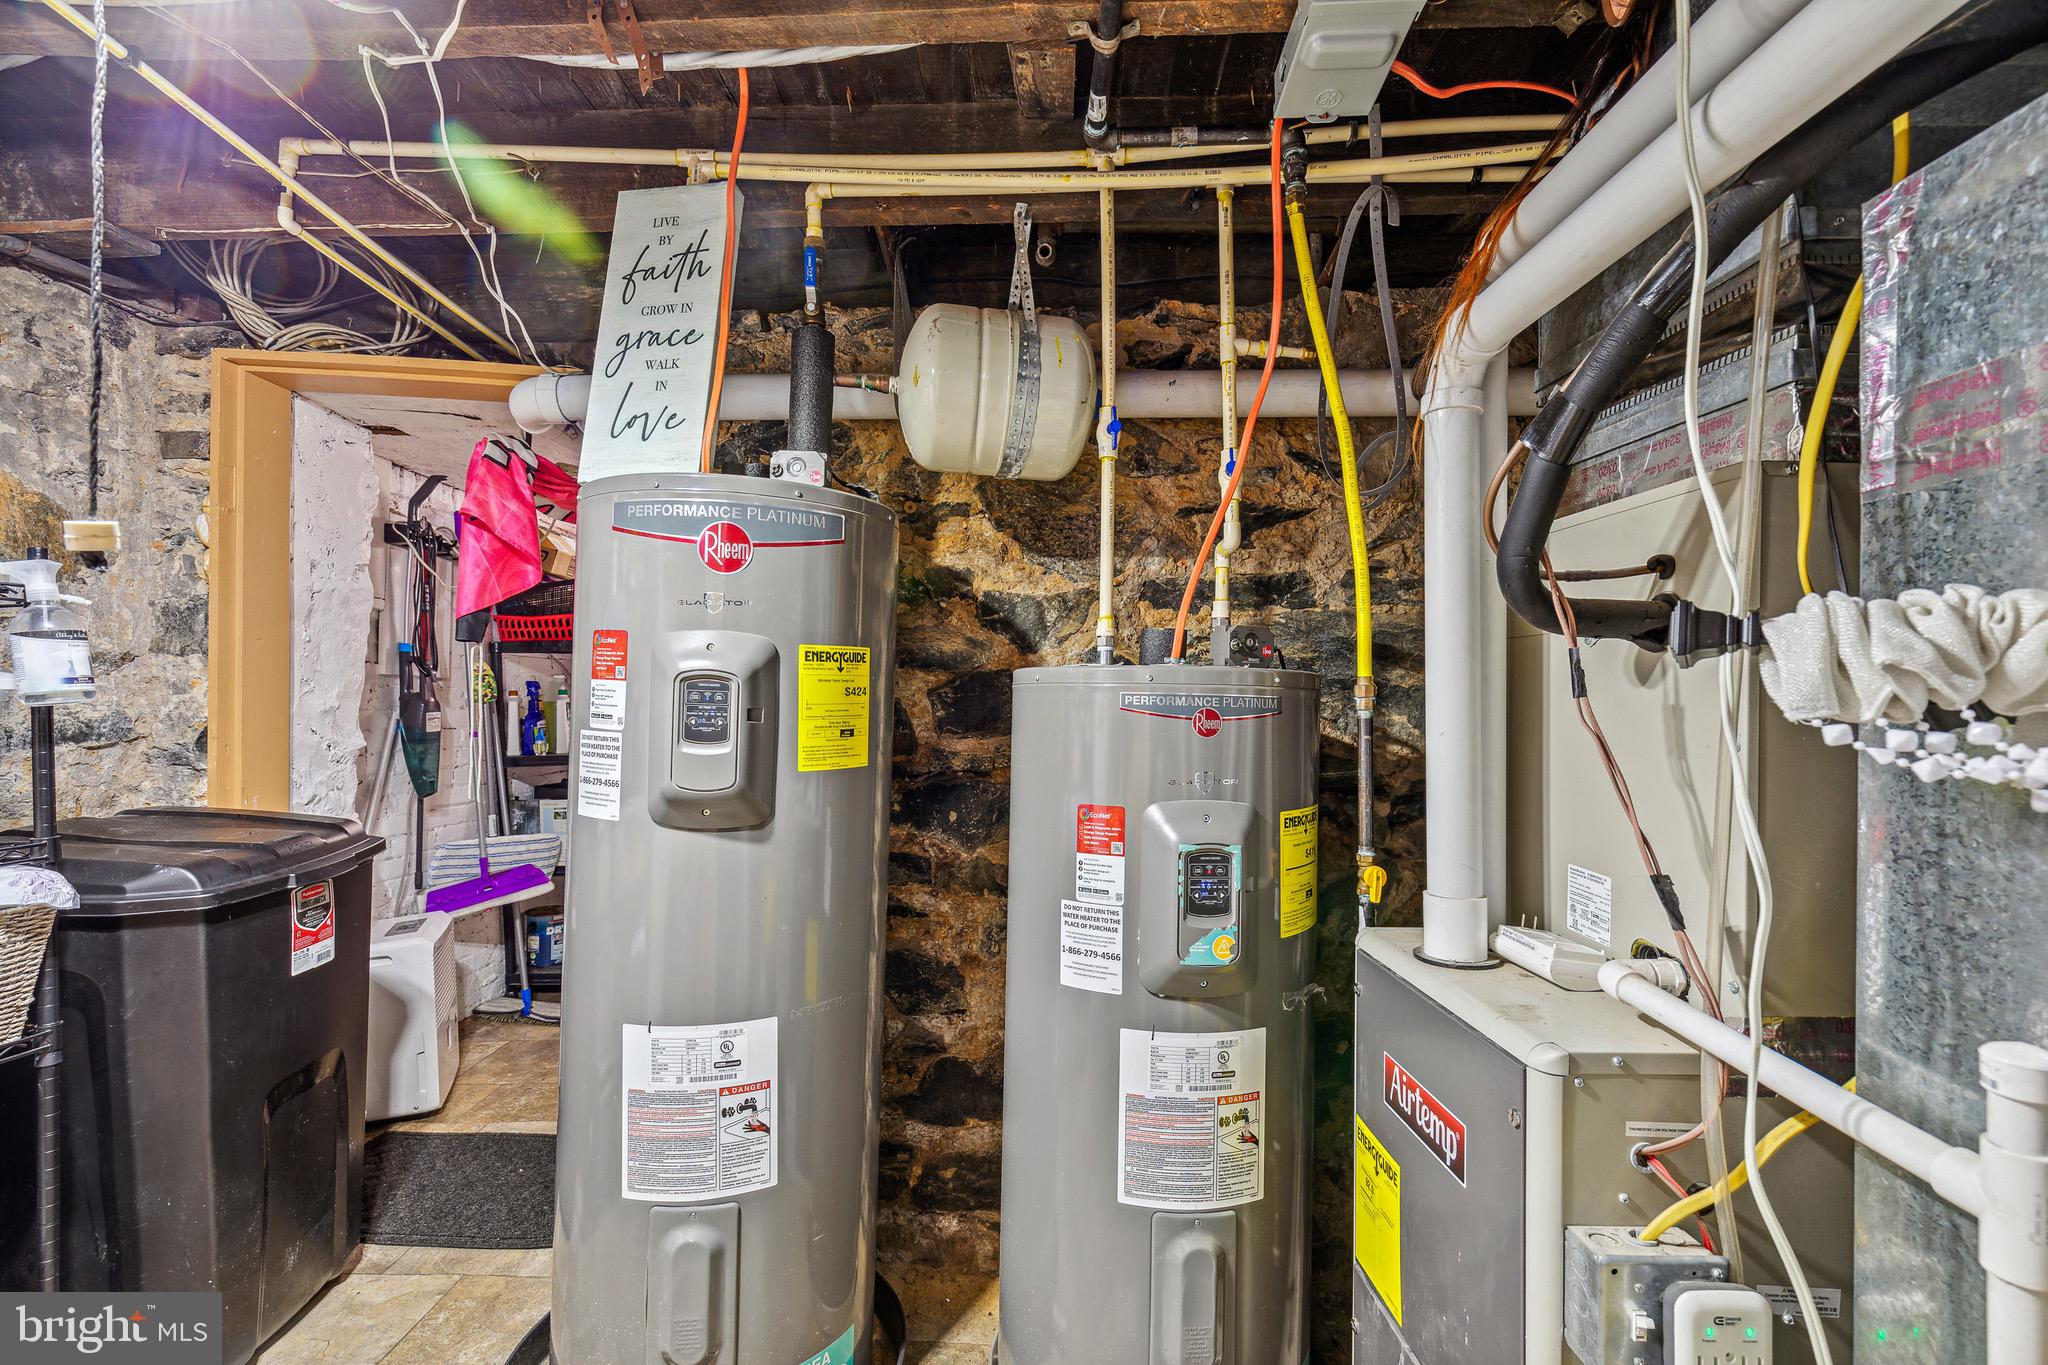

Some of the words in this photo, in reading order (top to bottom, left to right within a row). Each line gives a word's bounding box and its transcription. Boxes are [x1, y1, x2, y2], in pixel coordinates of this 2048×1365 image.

[1432, 153, 1472, 161] CHARLOTTE
[653, 216, 680, 228] LIVE
[659, 235, 674, 246] BY
[622, 229, 711, 305] faith
[641, 304, 678, 317] GROW
[680, 302, 694, 314] IN
[605, 328, 704, 378] grace
[645, 358, 680, 370] WALK
[655, 380, 668, 392] IN
[610, 382, 686, 442] love
[1658, 433, 1681, 450] 324A
[1598, 463, 1618, 477] 03/20
[1657, 457, 1681, 474] 324A
[627, 503, 743, 519] PERFORMANCE
[746, 507, 828, 530] PLATINUM
[703, 522, 750, 567] Rheem
[804, 650, 867, 664] ENERGYGUIDE
[1125, 695, 1220, 708] PERFORMANCE
[1222, 697, 1279, 709] PLATINUM
[1196, 708, 1221, 733] Rheem
[579, 775, 620, 788] 1-866-279-4566
[1090, 812, 1112, 820] EcoNet
[1063, 912, 1079, 920] WATER
[1080, 914, 1100, 923] HEATER
[1084, 906, 1105, 915] RETURN
[1107, 909, 1120, 917] THIS
[1064, 920, 1080, 929] PLACE
[1089, 924, 1119, 934] PURCHASE
[1062, 945, 1121, 962] 1-866-279-4566
[731, 1082, 768, 1094] DANGER
[1228, 1093, 1258, 1104] DANGER
[1389, 1064, 1458, 1168] Airtemp
[1357, 1125, 1398, 1188] ENERGYGUIDE
